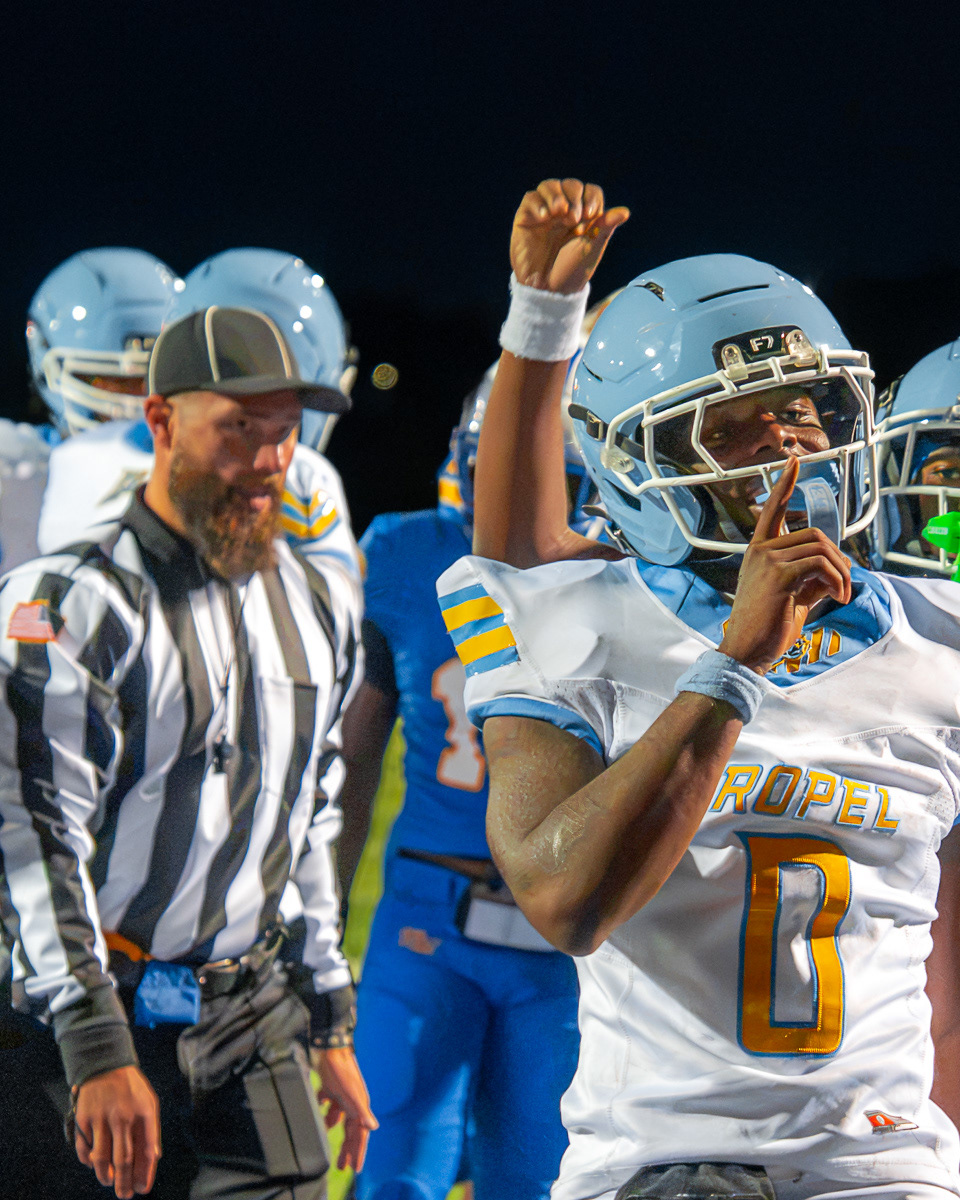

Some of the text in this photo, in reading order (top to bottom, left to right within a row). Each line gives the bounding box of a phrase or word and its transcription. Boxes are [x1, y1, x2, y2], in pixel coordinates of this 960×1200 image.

[749, 335, 774, 352] F7
[708, 763, 902, 833] ROPEL
[736, 831, 852, 1058] 0
